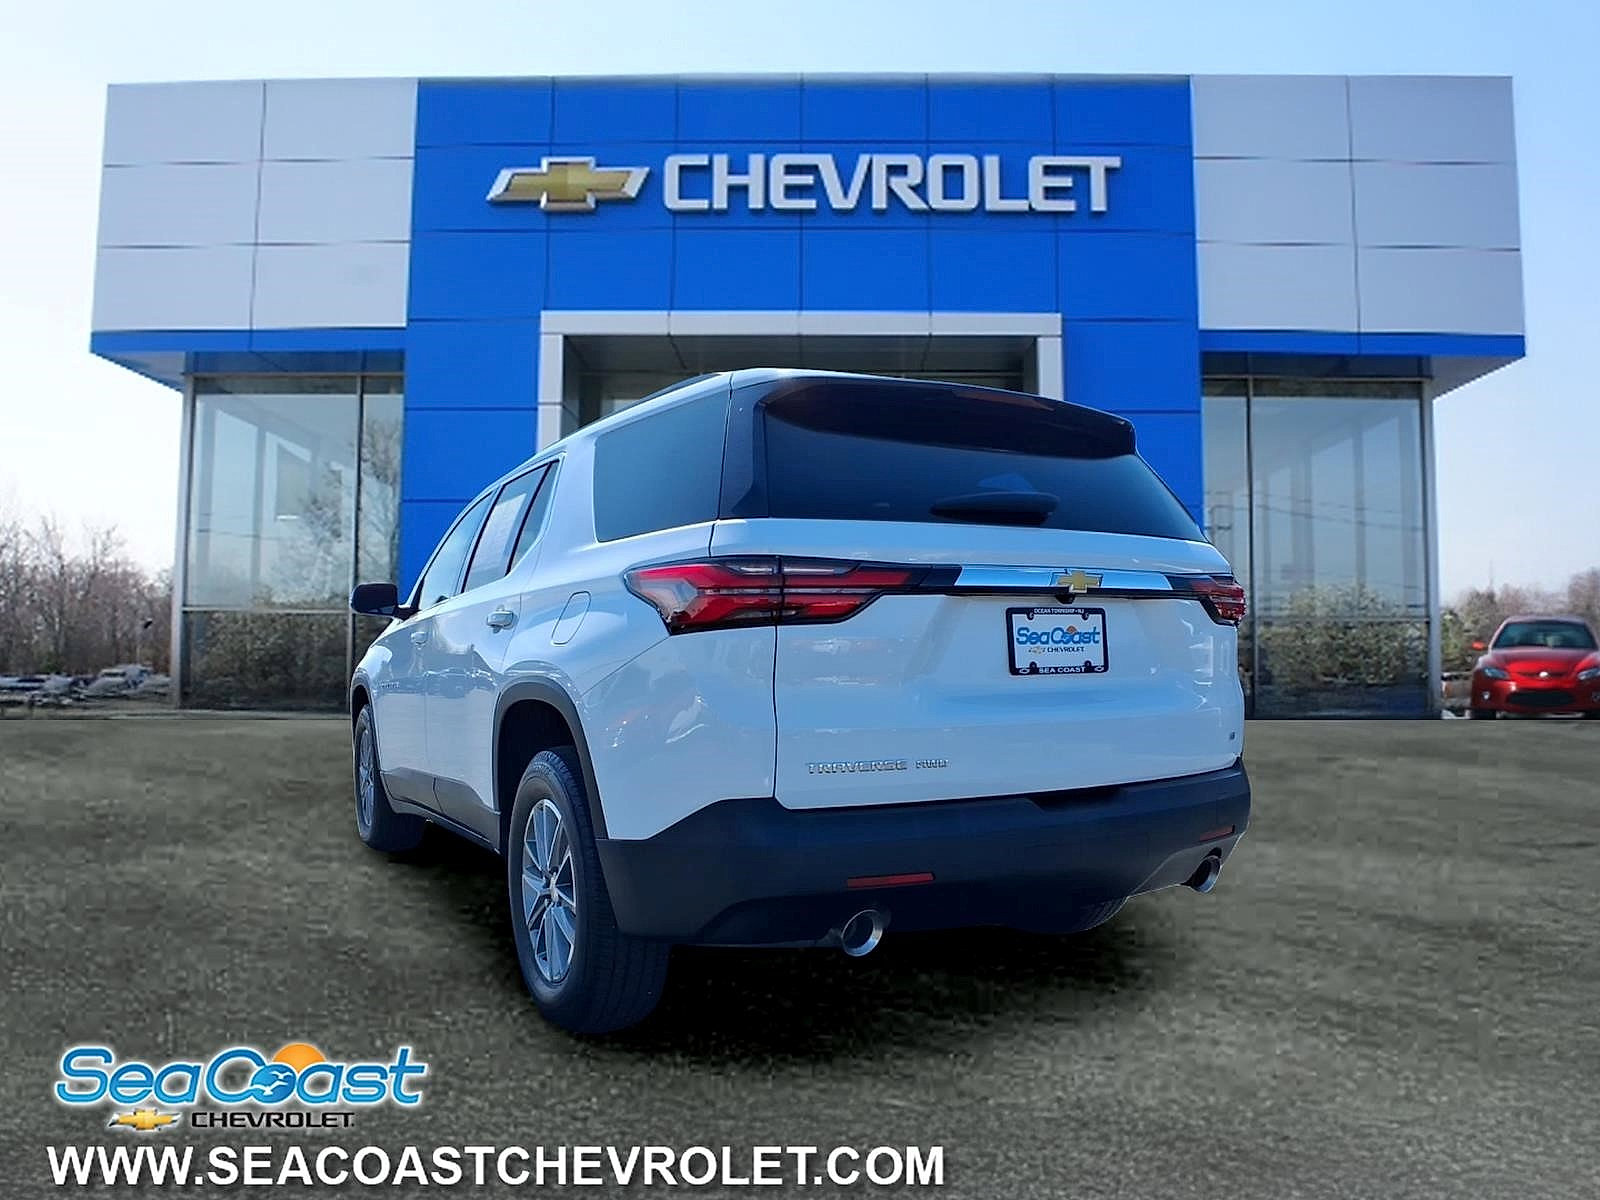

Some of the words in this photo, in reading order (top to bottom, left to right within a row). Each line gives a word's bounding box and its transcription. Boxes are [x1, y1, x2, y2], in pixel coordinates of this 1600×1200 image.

[663, 153, 1121, 213] CHEVROLET
[806, 758, 908, 774] TRAVERSE
[915, 758, 949, 769] AWD
